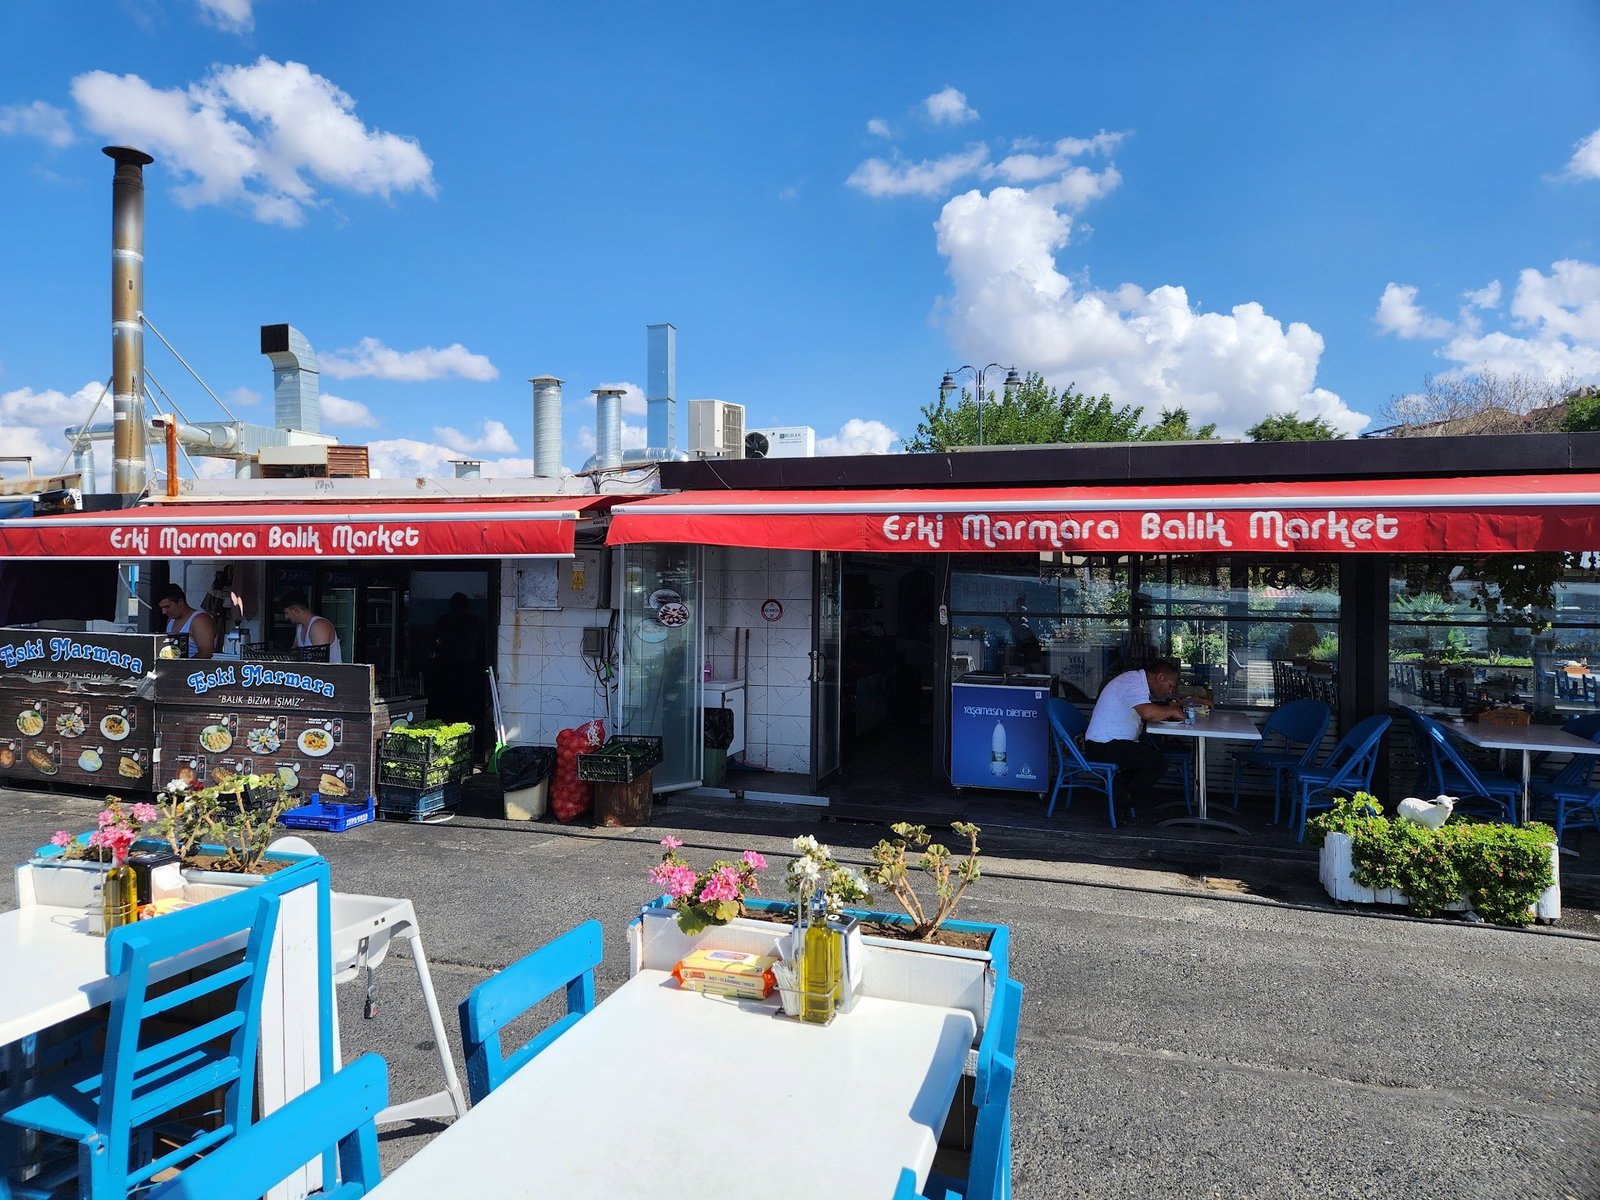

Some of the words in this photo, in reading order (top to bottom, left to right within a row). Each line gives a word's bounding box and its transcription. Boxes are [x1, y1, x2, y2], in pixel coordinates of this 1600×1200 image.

[110, 527, 149, 554] Eski
[159, 527, 257, 554] Marmara
[267, 526, 323, 554] Balık
[332, 525, 419, 553] Market
[882, 515, 943, 549] Eski
[961, 514, 1120, 549] Marmara
[1140, 512, 1233, 548] Balık
[1248, 510, 1399, 548] Market
[0, 638, 45, 668] Eski
[49, 637, 143, 674] Marmara
[187, 665, 236, 694] Eski
[241, 664, 335, 698] Marmara
[247, 695, 271, 706] BİZİM
